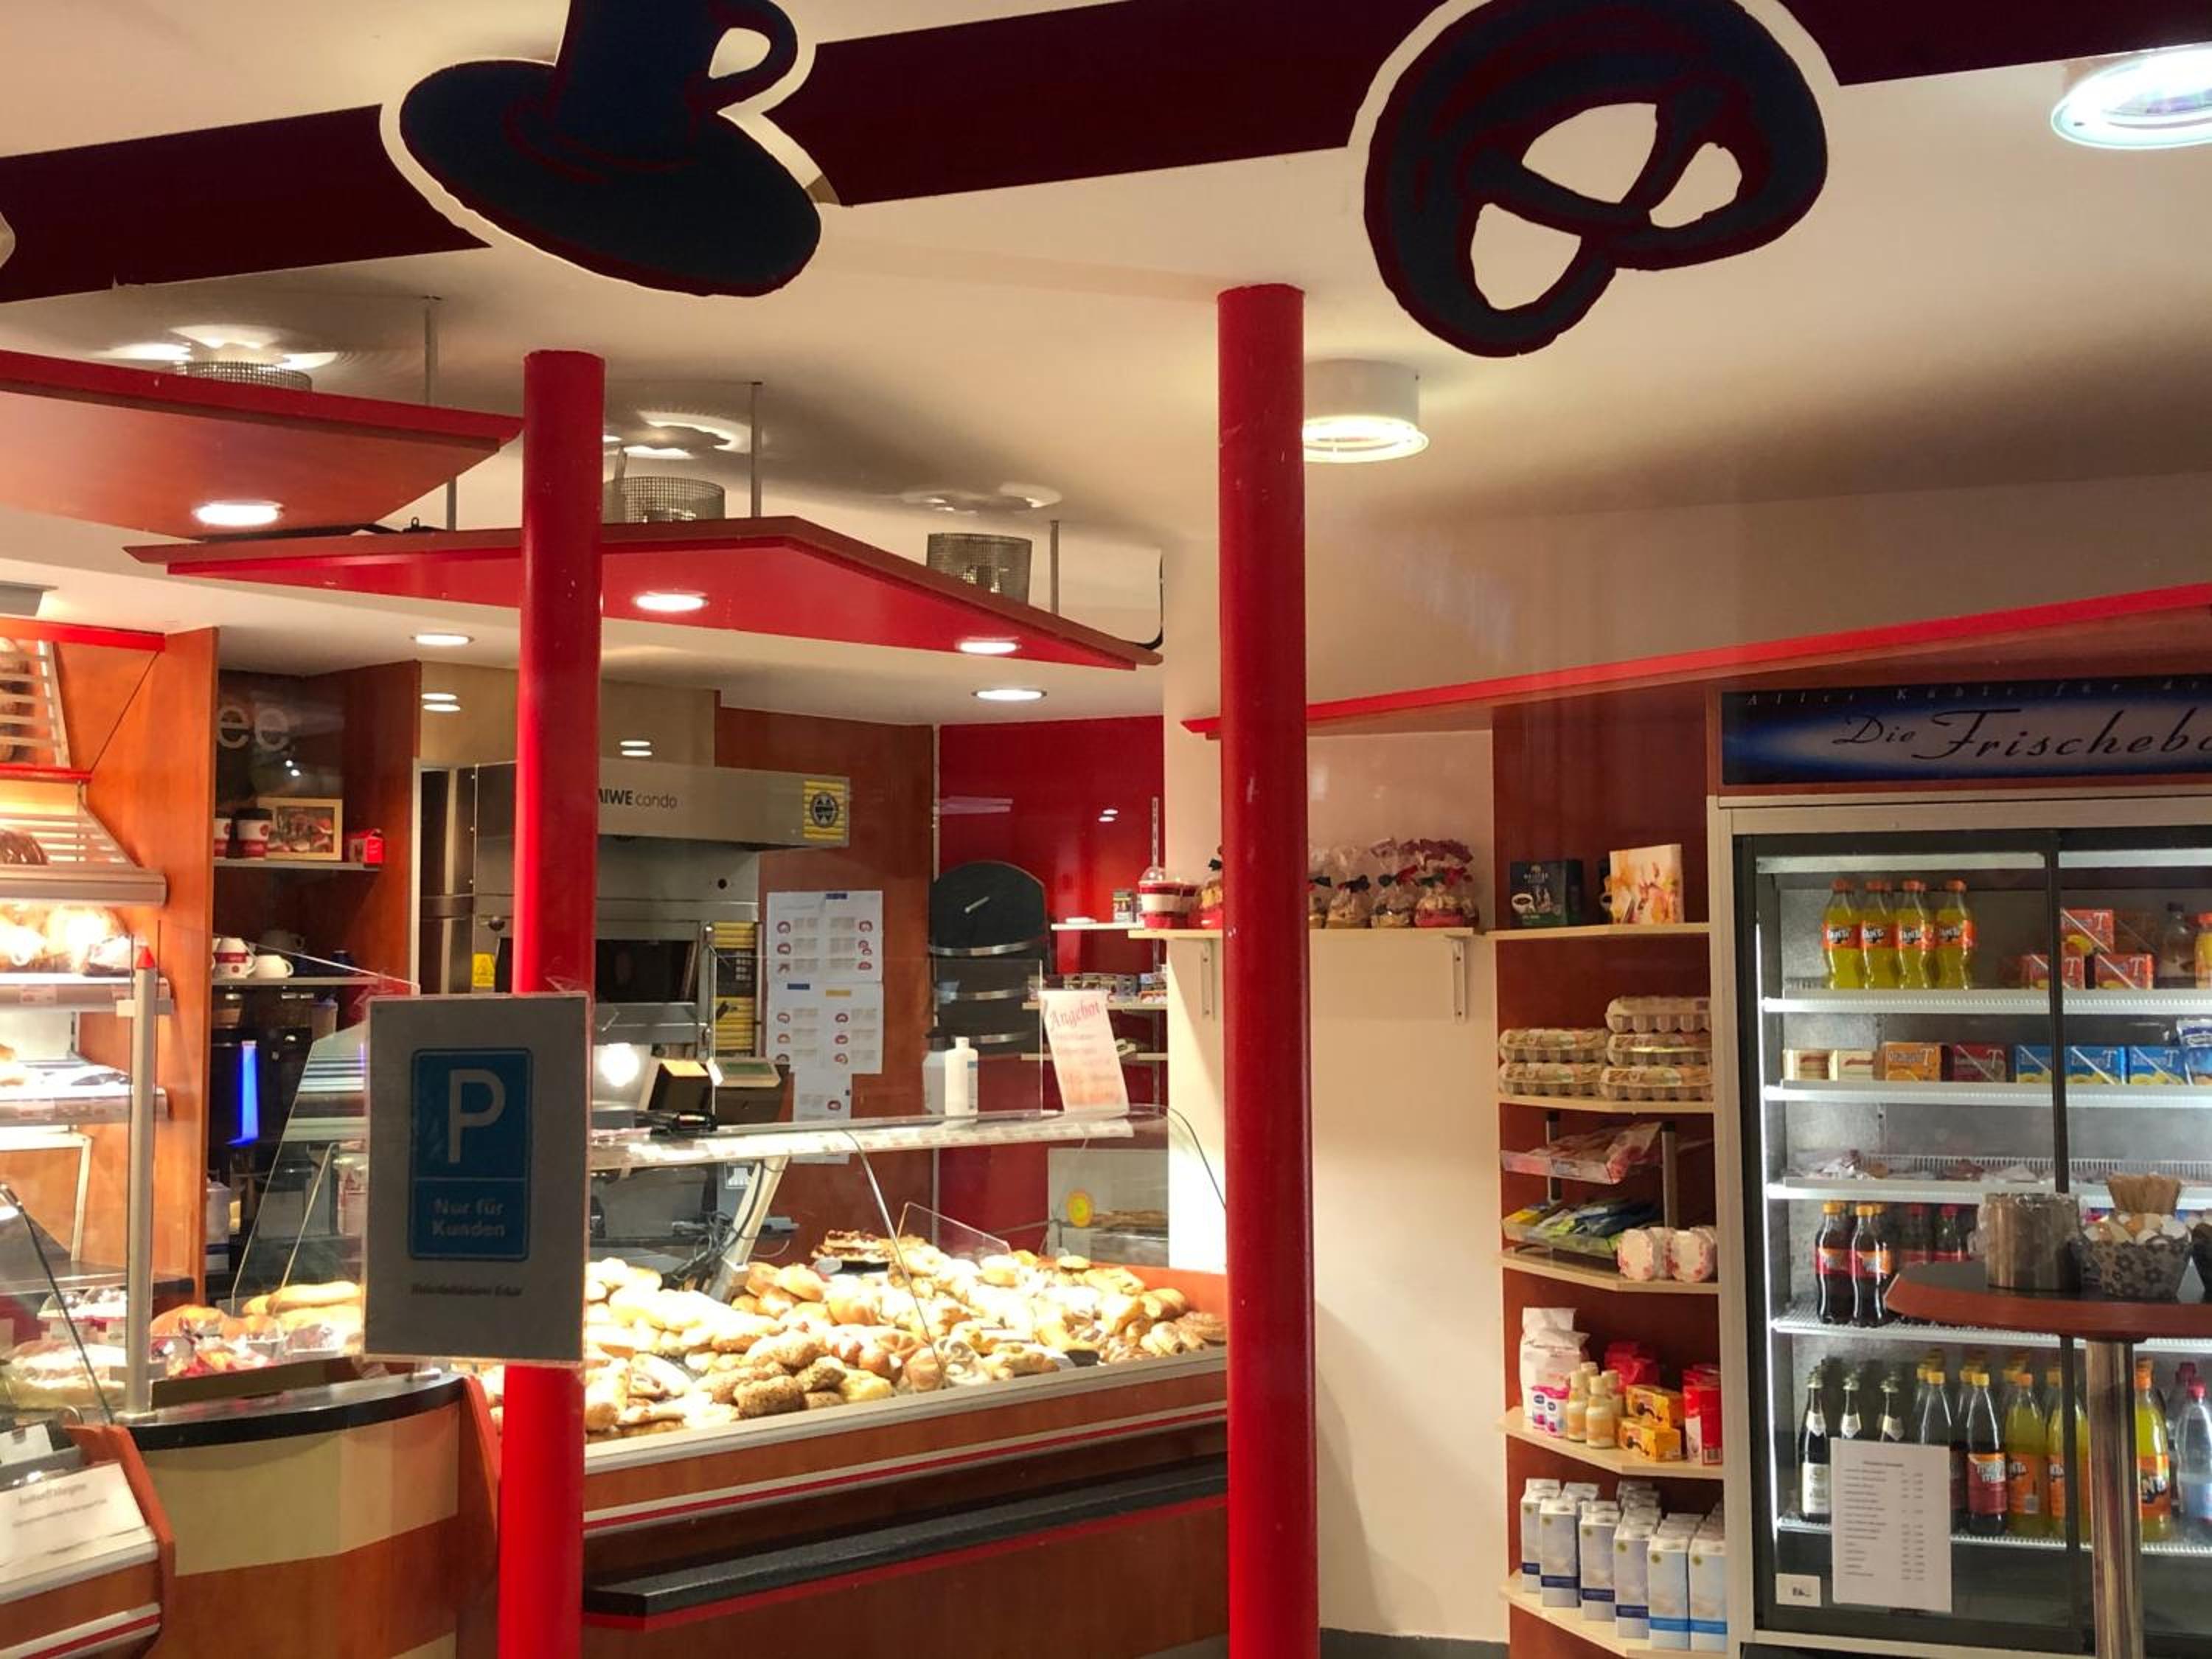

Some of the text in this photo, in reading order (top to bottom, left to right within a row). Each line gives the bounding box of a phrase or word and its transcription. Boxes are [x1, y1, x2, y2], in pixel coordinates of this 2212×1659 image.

[1832, 714, 1916, 745] Die
[635, 793, 678, 809] condo
[448, 1068, 506, 1164] P
[433, 1198, 470, 1216] Nur
[431, 1220, 506, 1239] Kunden
